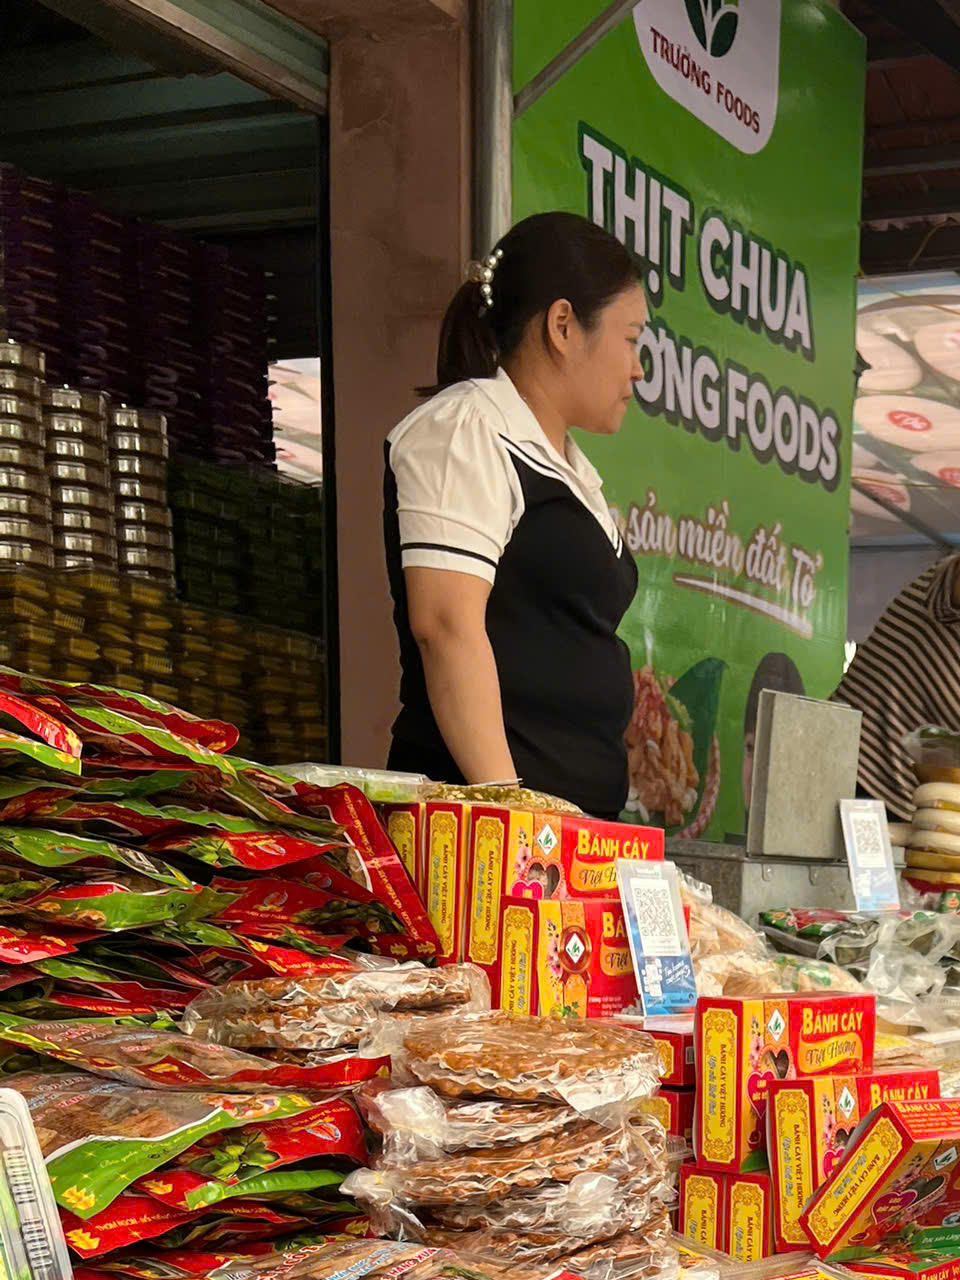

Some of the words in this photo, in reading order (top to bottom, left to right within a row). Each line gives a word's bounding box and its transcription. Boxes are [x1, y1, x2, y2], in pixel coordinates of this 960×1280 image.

[716, 85, 760, 134] FOODS
[582, 133, 690, 294] THỊT
[700, 216, 812, 351] CHUA
[726, 368, 839, 482] FOODS
[442, 844, 450, 864] BÁNH
[578, 829, 621, 858] BÁNH
[623, 837, 649, 860] CÁY
[487, 850, 495, 870] BÁNH
[602, 910, 626, 939] BÁ
[803, 1007, 839, 1035] BÁNH
[841, 1008, 864, 1032] CÁY
[719, 1043, 727, 1065] BÁNH
[718, 1083, 727, 1100] VIỆT
[793, 1124, 801, 1145] BÁNH
[795, 1163, 803, 1181] VIỆT
[746, 1216, 754, 1235] BÁNH
